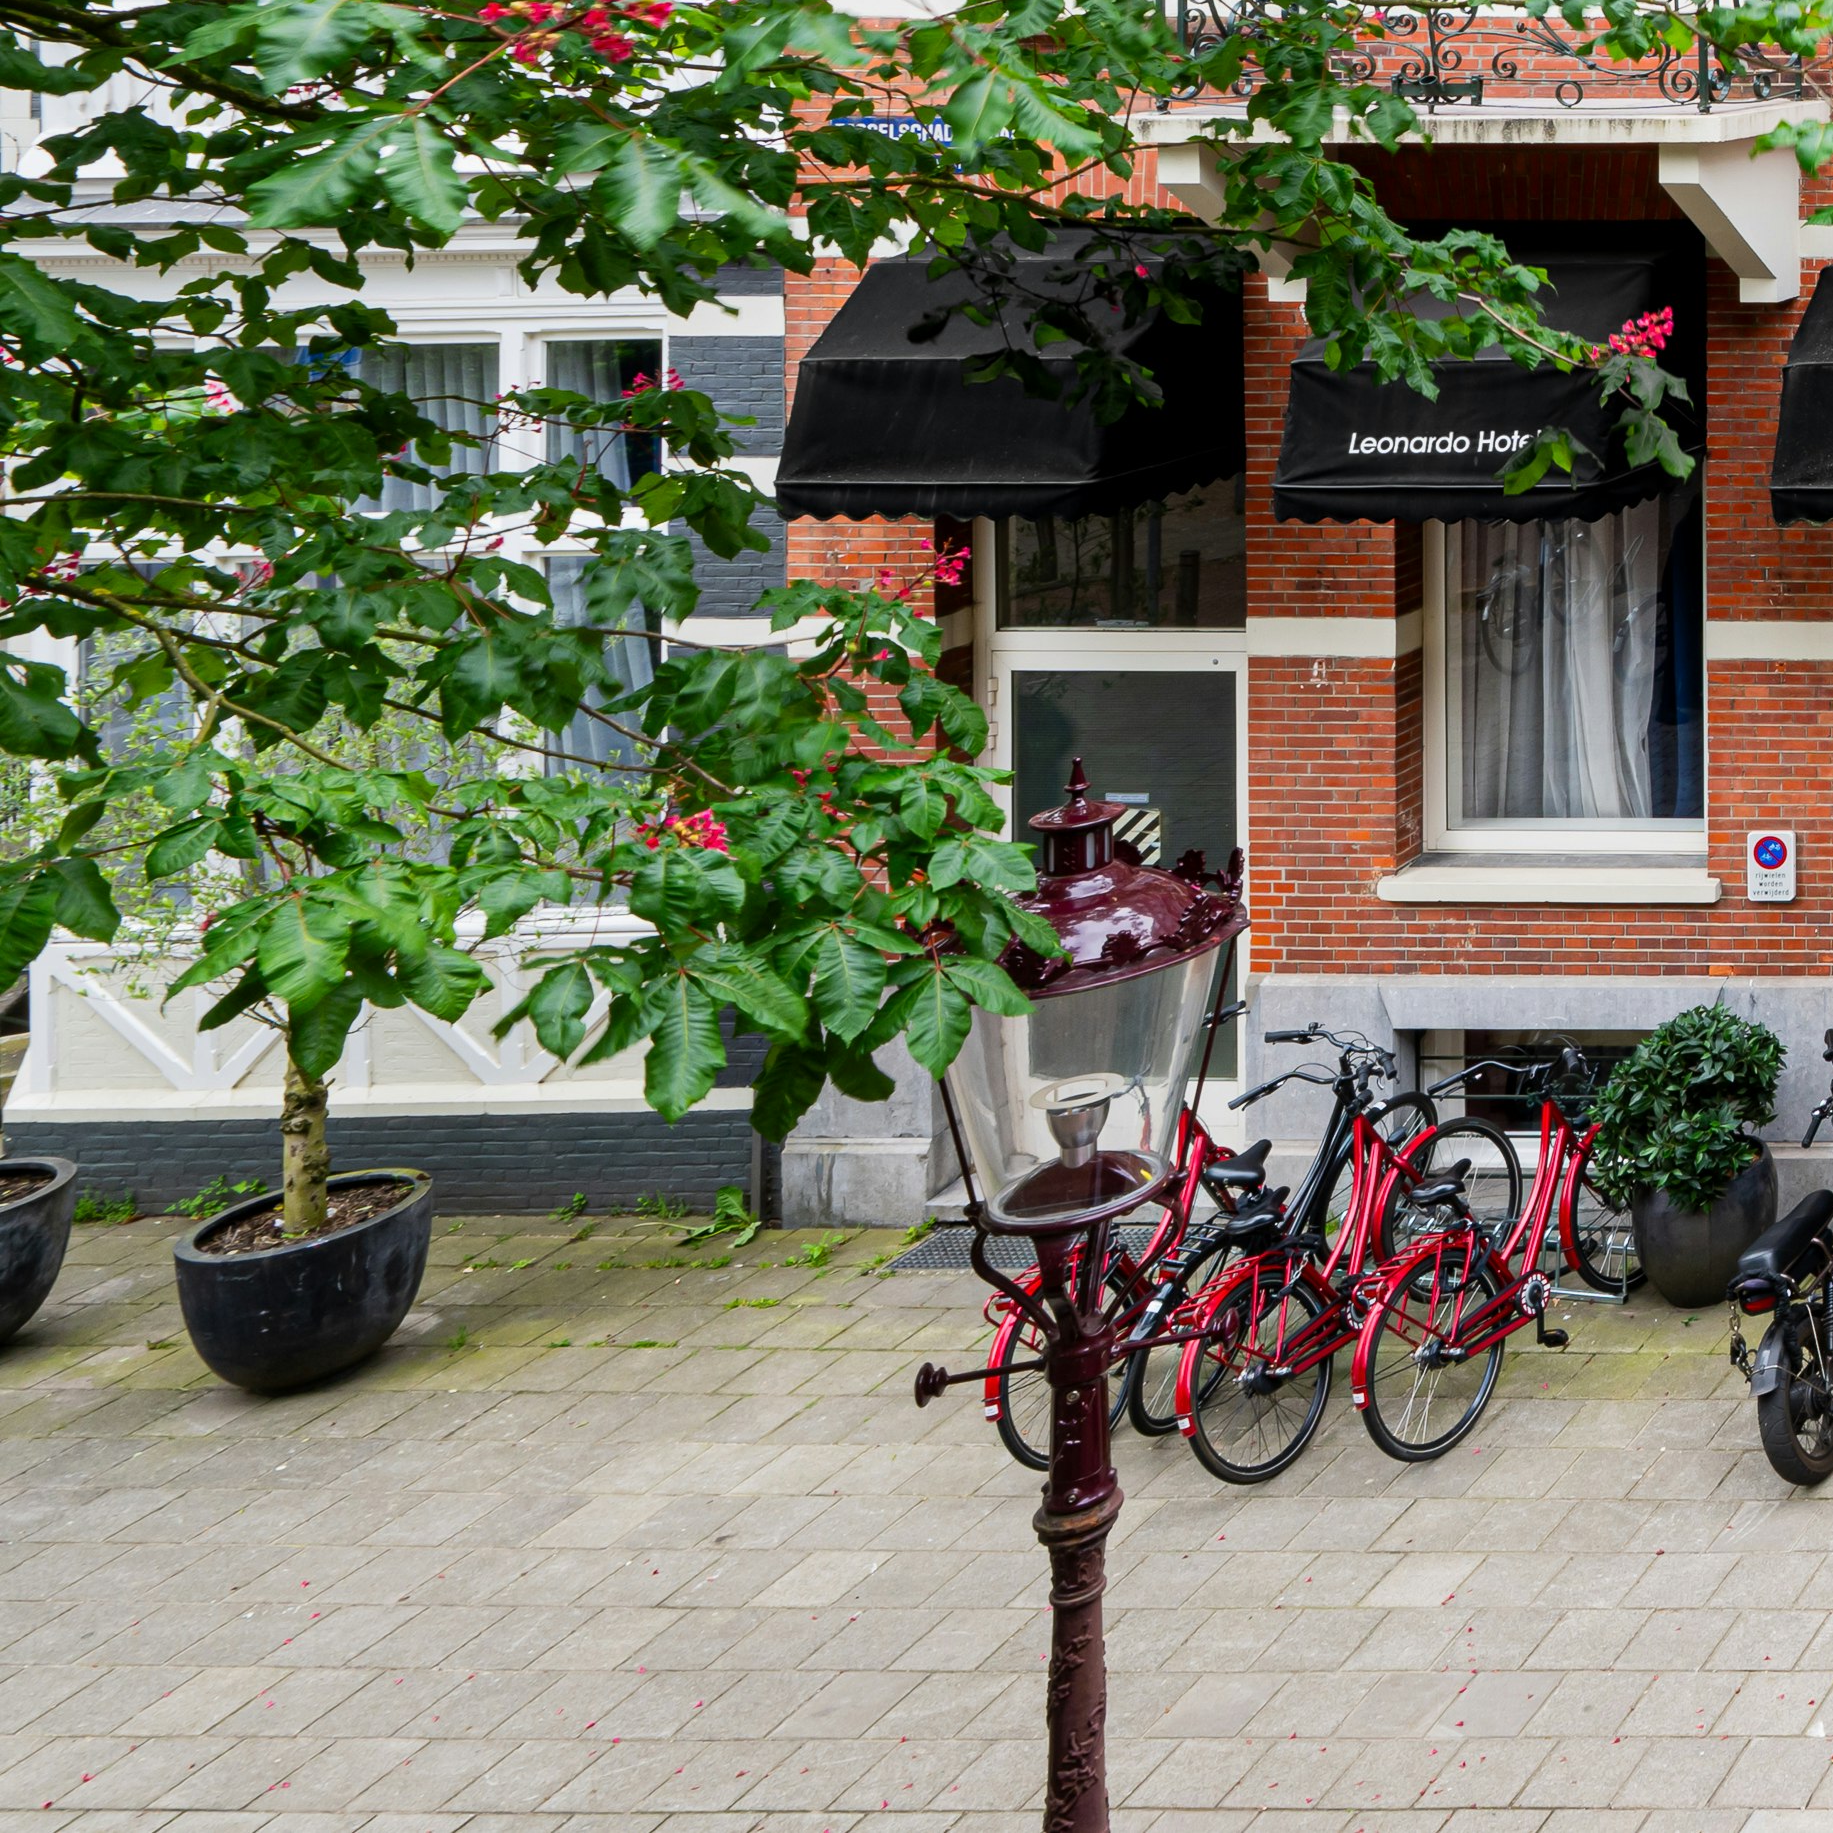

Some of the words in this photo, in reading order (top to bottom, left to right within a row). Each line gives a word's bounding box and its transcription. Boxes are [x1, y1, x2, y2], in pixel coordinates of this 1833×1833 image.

[1347, 430, 1472, 455] Leonardo
[1476, 428, 1543, 454] Hote
[1755, 871, 1787, 881] rijwielen
[1752, 888, 1791, 898] verwijderd
